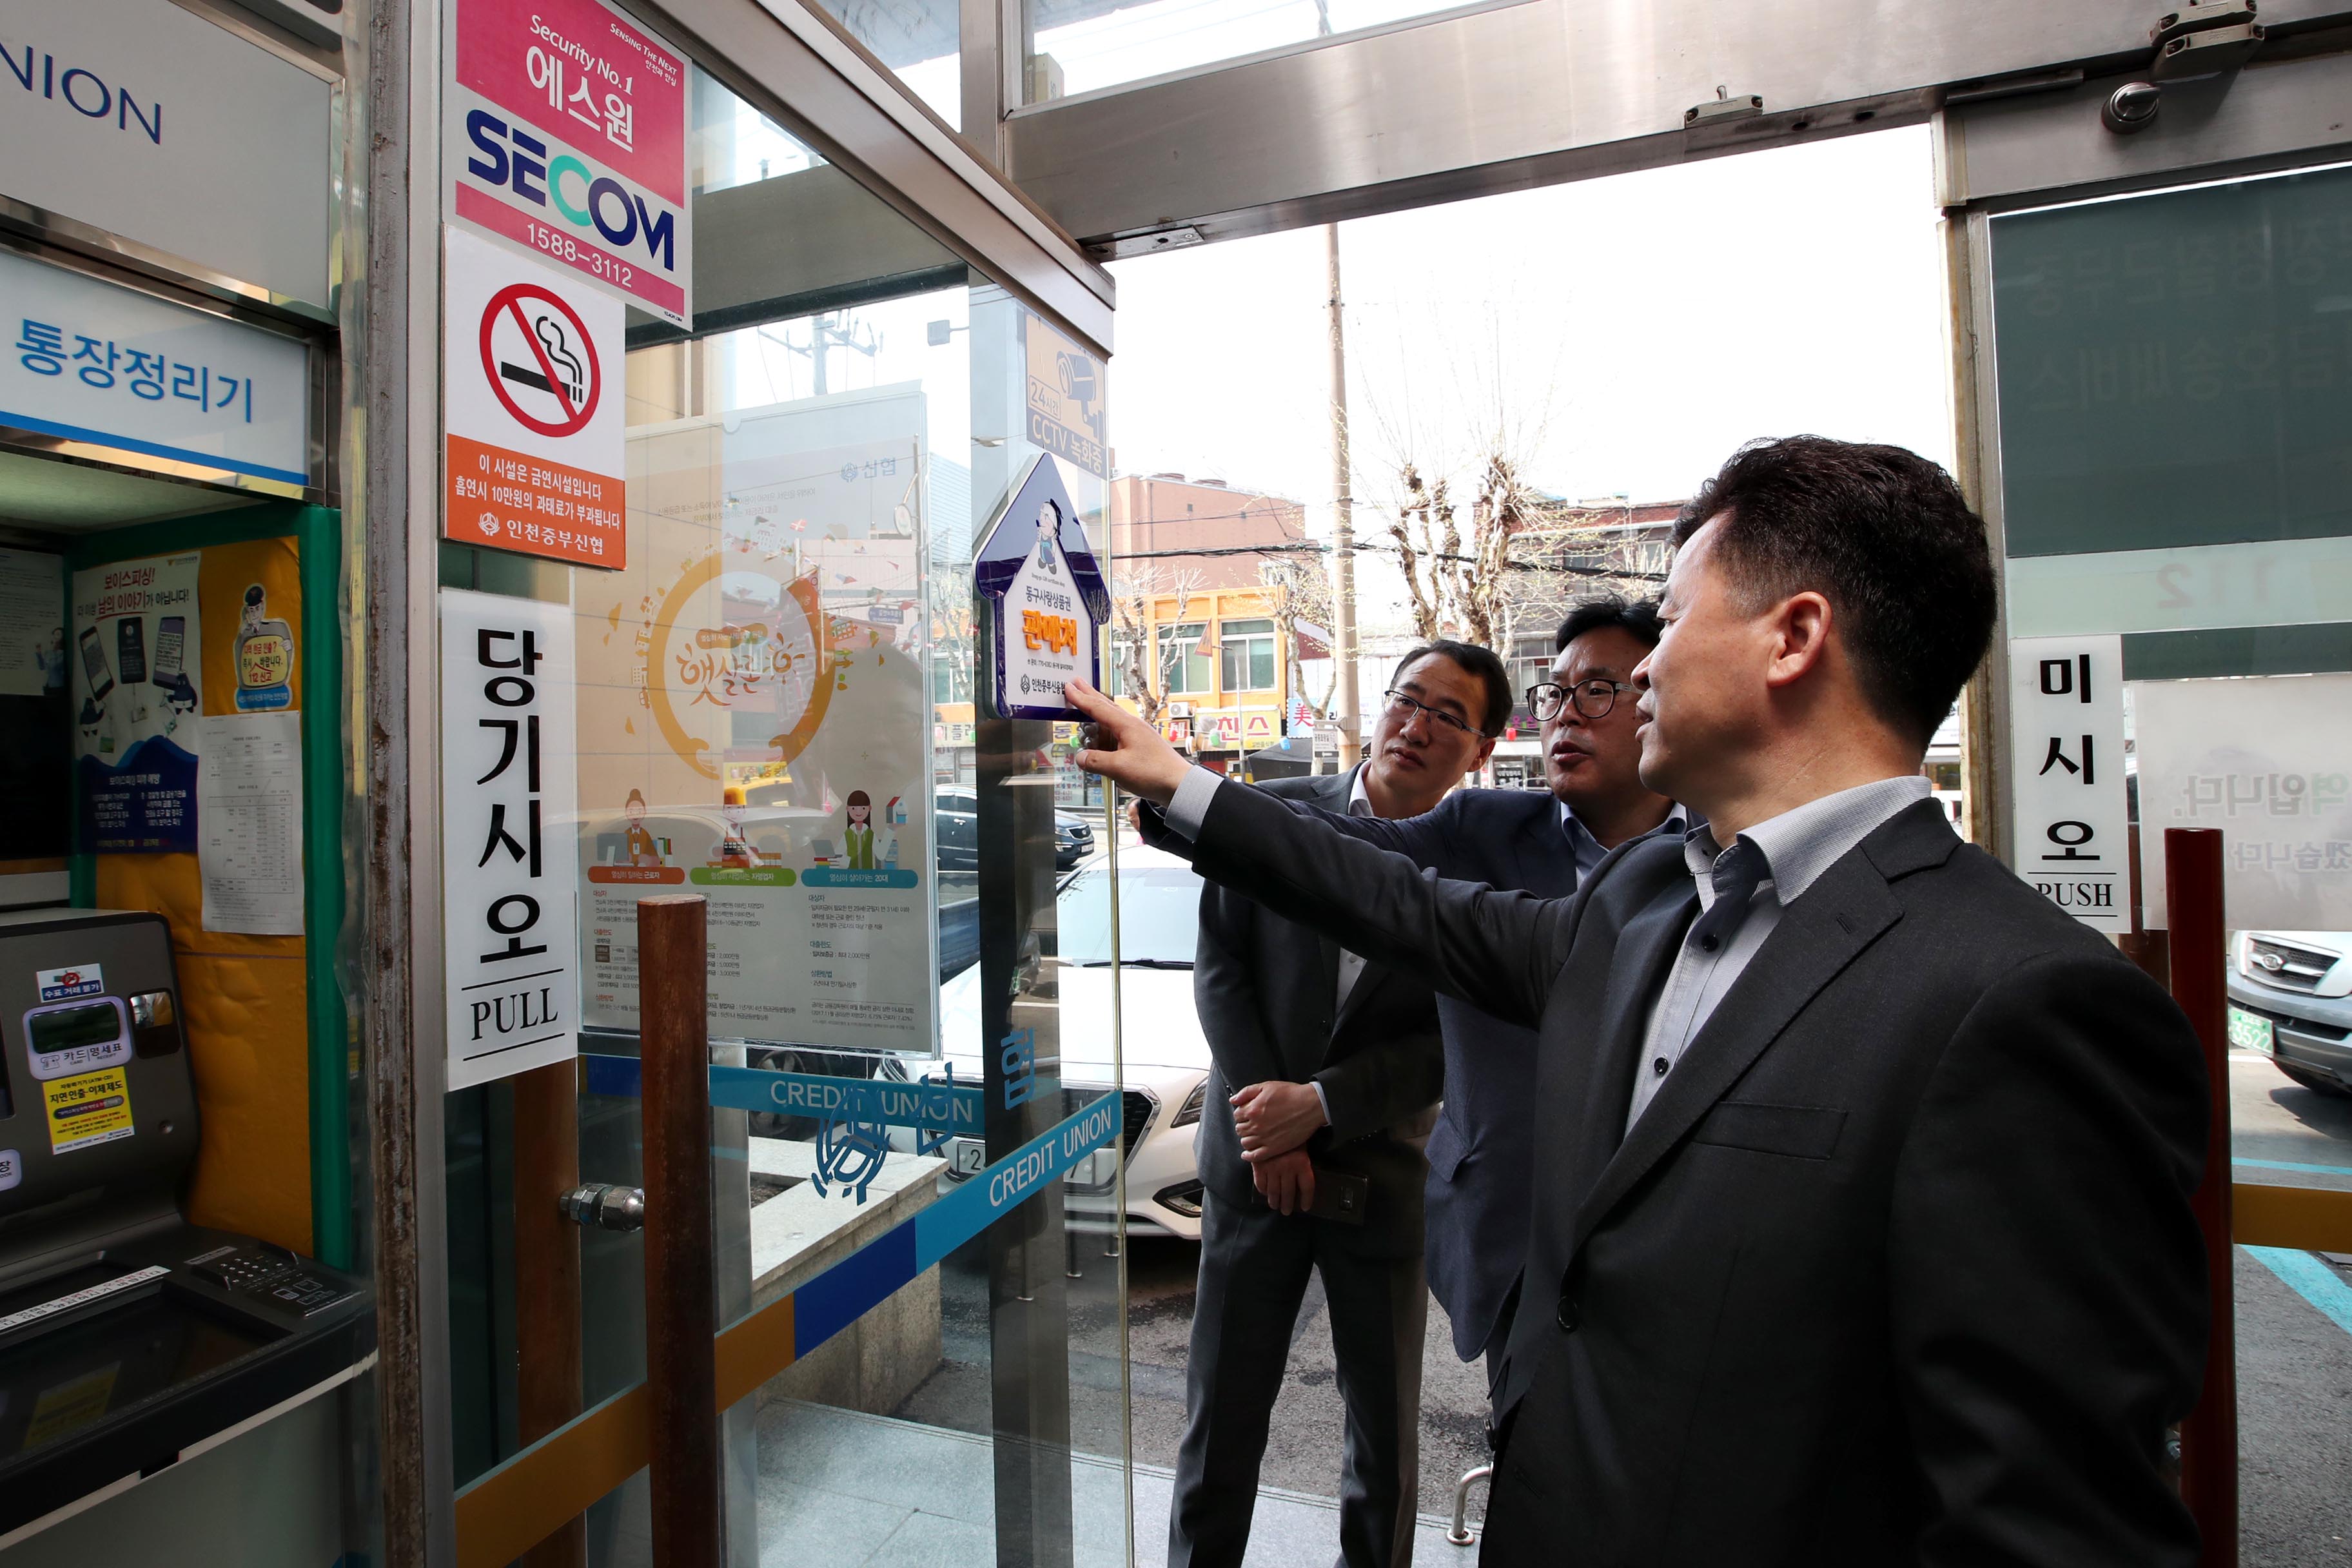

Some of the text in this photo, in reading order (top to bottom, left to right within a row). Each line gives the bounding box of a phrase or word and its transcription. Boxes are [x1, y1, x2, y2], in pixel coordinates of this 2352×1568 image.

[529, 14, 633, 96] Security No.1
[610, 23, 677, 75] SENSING THE NEXT
[525, 46, 633, 153] 에스원
[665, 73, 677, 87] 안심
[466, 109, 674, 272] SECOM
[527, 222, 632, 288] 1588-3112
[15, 318, 253, 423] 통장정리기
[1031, 380, 1059, 417] 24시간
[1033, 414, 1102, 473] CCTV 녹화중
[479, 454, 602, 502] 이 시설은 금연시설입니다
[862, 458, 896, 479] 신협
[455, 475, 620, 531] 흡연시 10만원의 과태료가 부과됩니다
[506, 519, 603, 555] 인천중부신협
[104, 567, 155, 589] 보이스피싱!
[1025, 585, 1072, 612] 동구사랑상품권
[97, 594, 115, 614] 남의
[117, 590, 154, 611] 이야기가
[1021, 609, 1078, 656] 판매처
[260, 672, 271, 682] 신고
[676, 643, 761, 707] 햇살론
[1217, 716, 1270, 741] 찬스
[1293, 703, 1315, 727] 美
[2039, 654, 2101, 862] 미시오
[476, 629, 547, 964] 당기시오
[829, 874, 888, 883] 열심히 살아가는 20대
[2035, 882, 2113, 907] PUSH
[44, 990, 62, 998] 수표
[83, 984, 99, 992] 불가
[470, 987, 558, 1041] PULL
[64, 1043, 122, 1061] 카드 명세표
[2232, 1021, 2270, 1054] 3522
[769, 1080, 972, 1124] CREDIT UNION
[988, 1104, 1112, 1208] CREDIT UNION
